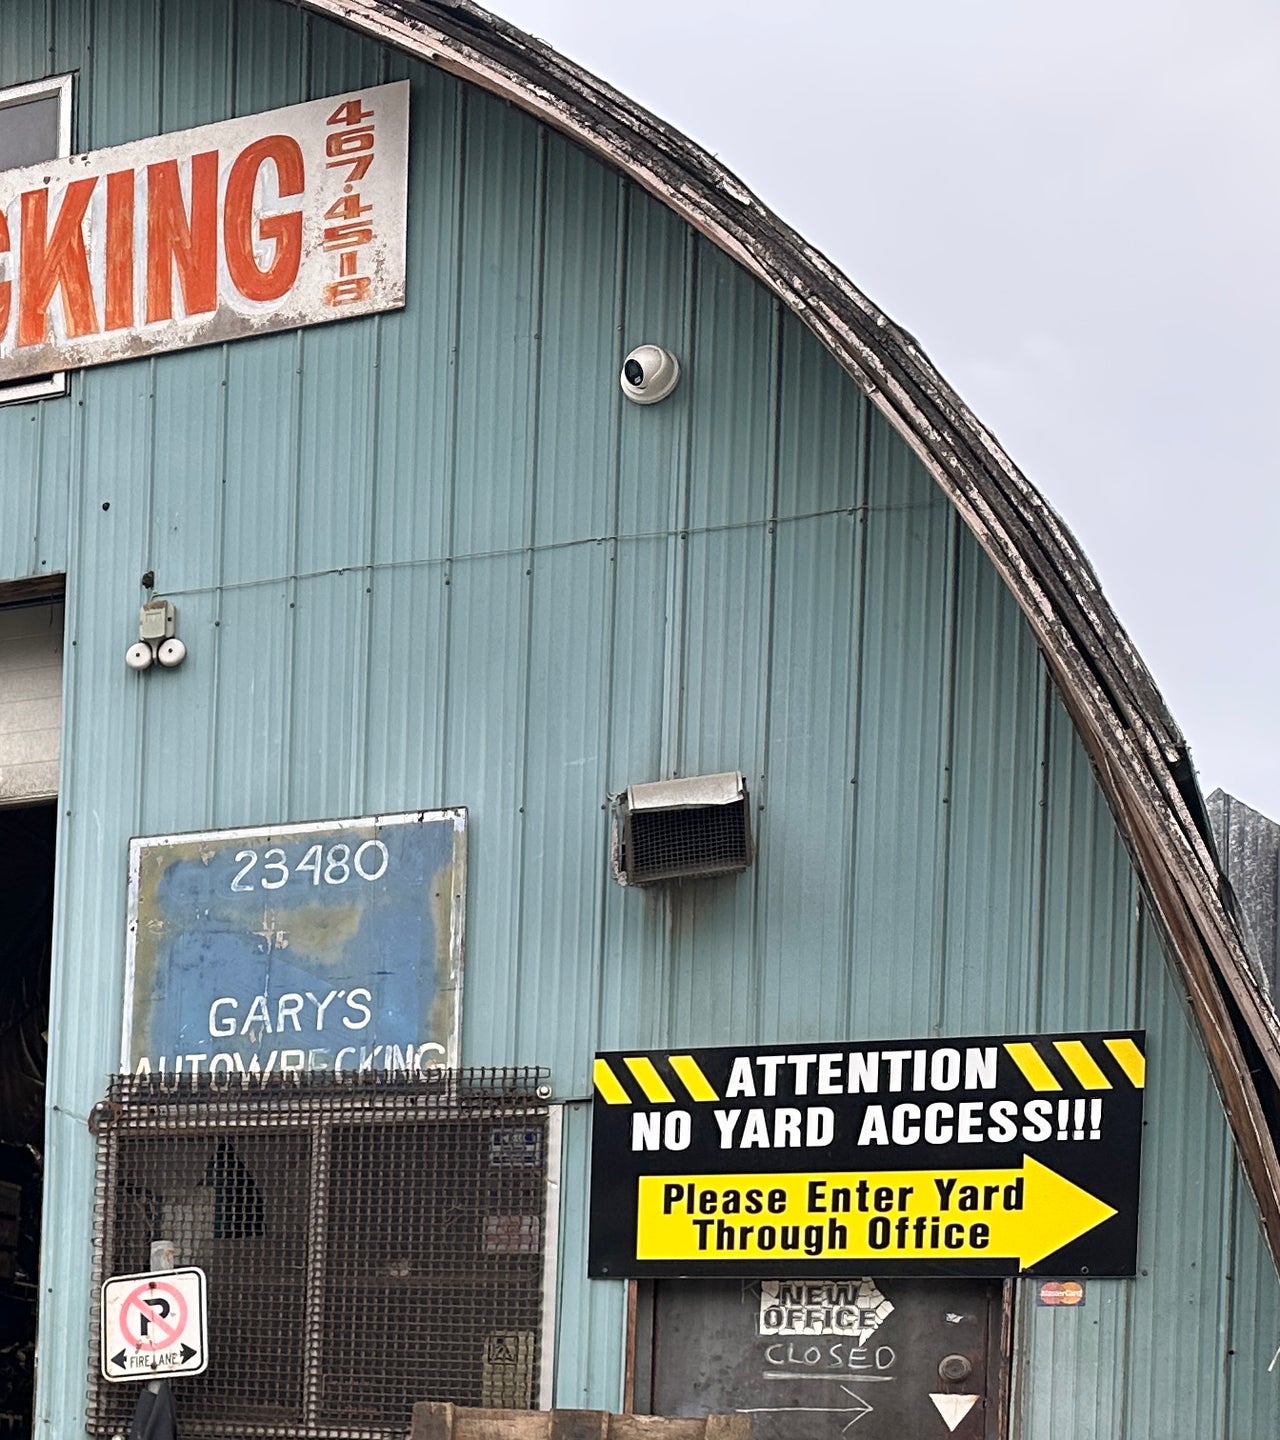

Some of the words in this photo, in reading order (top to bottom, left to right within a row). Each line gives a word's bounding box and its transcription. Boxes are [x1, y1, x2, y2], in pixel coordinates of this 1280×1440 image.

[230, 840, 390, 892] 23480
[208, 988, 373, 1037] GARY'S
[725, 1047, 998, 1098] ATTENTION
[631, 1110, 692, 1151] NO
[715, 1105, 835, 1149] YARD
[857, 1097, 1104, 1147] ACCESS!!!
[663, 1182, 787, 1215] Please
[808, 1181, 914, 1213] Enter
[934, 1177, 1025, 1211] Yard
[693, 1219, 847, 1255] Through
[868, 1216, 991, 1249] Office
[781, 1285, 857, 1306] NEW
[763, 1305, 876, 1329] OFFICE
[130, 1355, 150, 1369] FIRE
[765, 1342, 896, 1370] CLOSED
